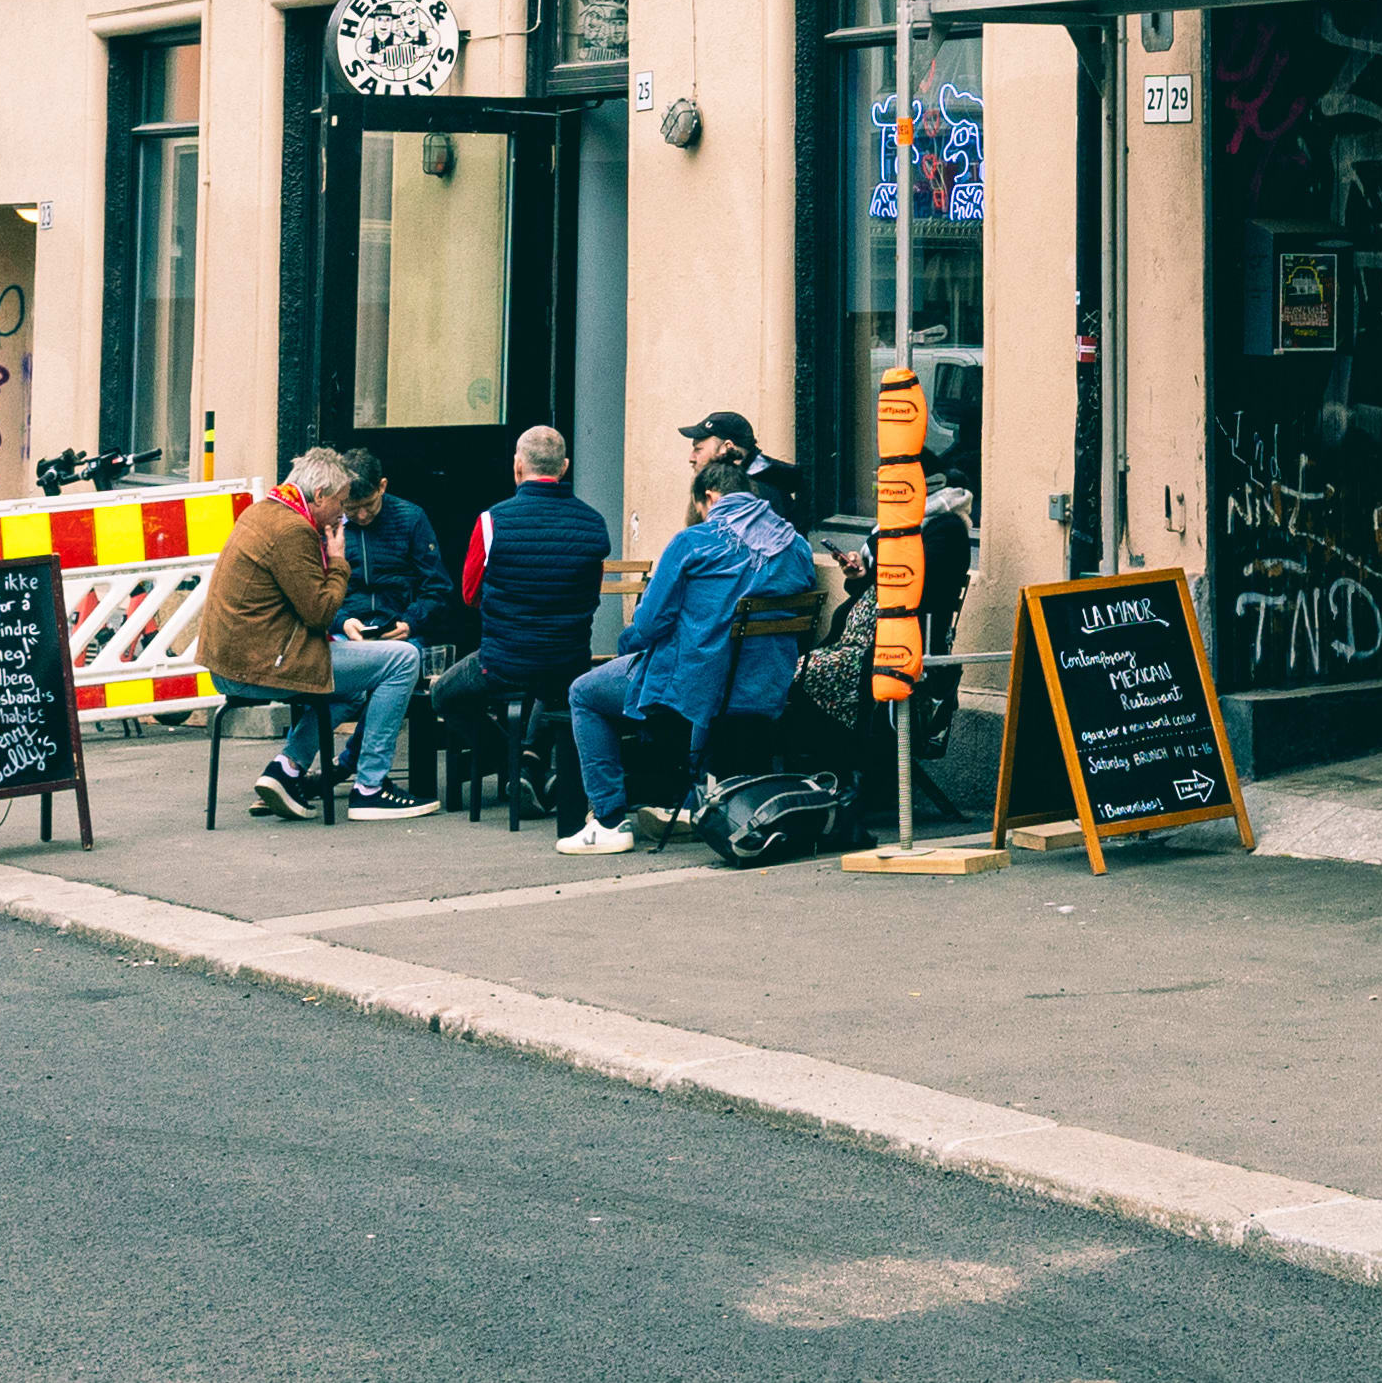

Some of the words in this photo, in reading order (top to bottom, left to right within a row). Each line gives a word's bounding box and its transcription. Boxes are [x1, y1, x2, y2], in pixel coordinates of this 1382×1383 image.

[429, 0, 449, 26] &
[638, 81, 651, 101] 25
[1147, 88, 1164, 110] 27
[1171, 87, 1188, 110] 29
[42, 204, 52, 226] 23
[5, 573, 38, 591] ikke
[22, 592, 31, 611] å
[1082, 605, 1105, 628] LA
[1109, 661, 1173, 691] MEXICAN
[1087, 755, 1131, 774] Saturday
[1133, 746, 1170, 766] BRUNCH
